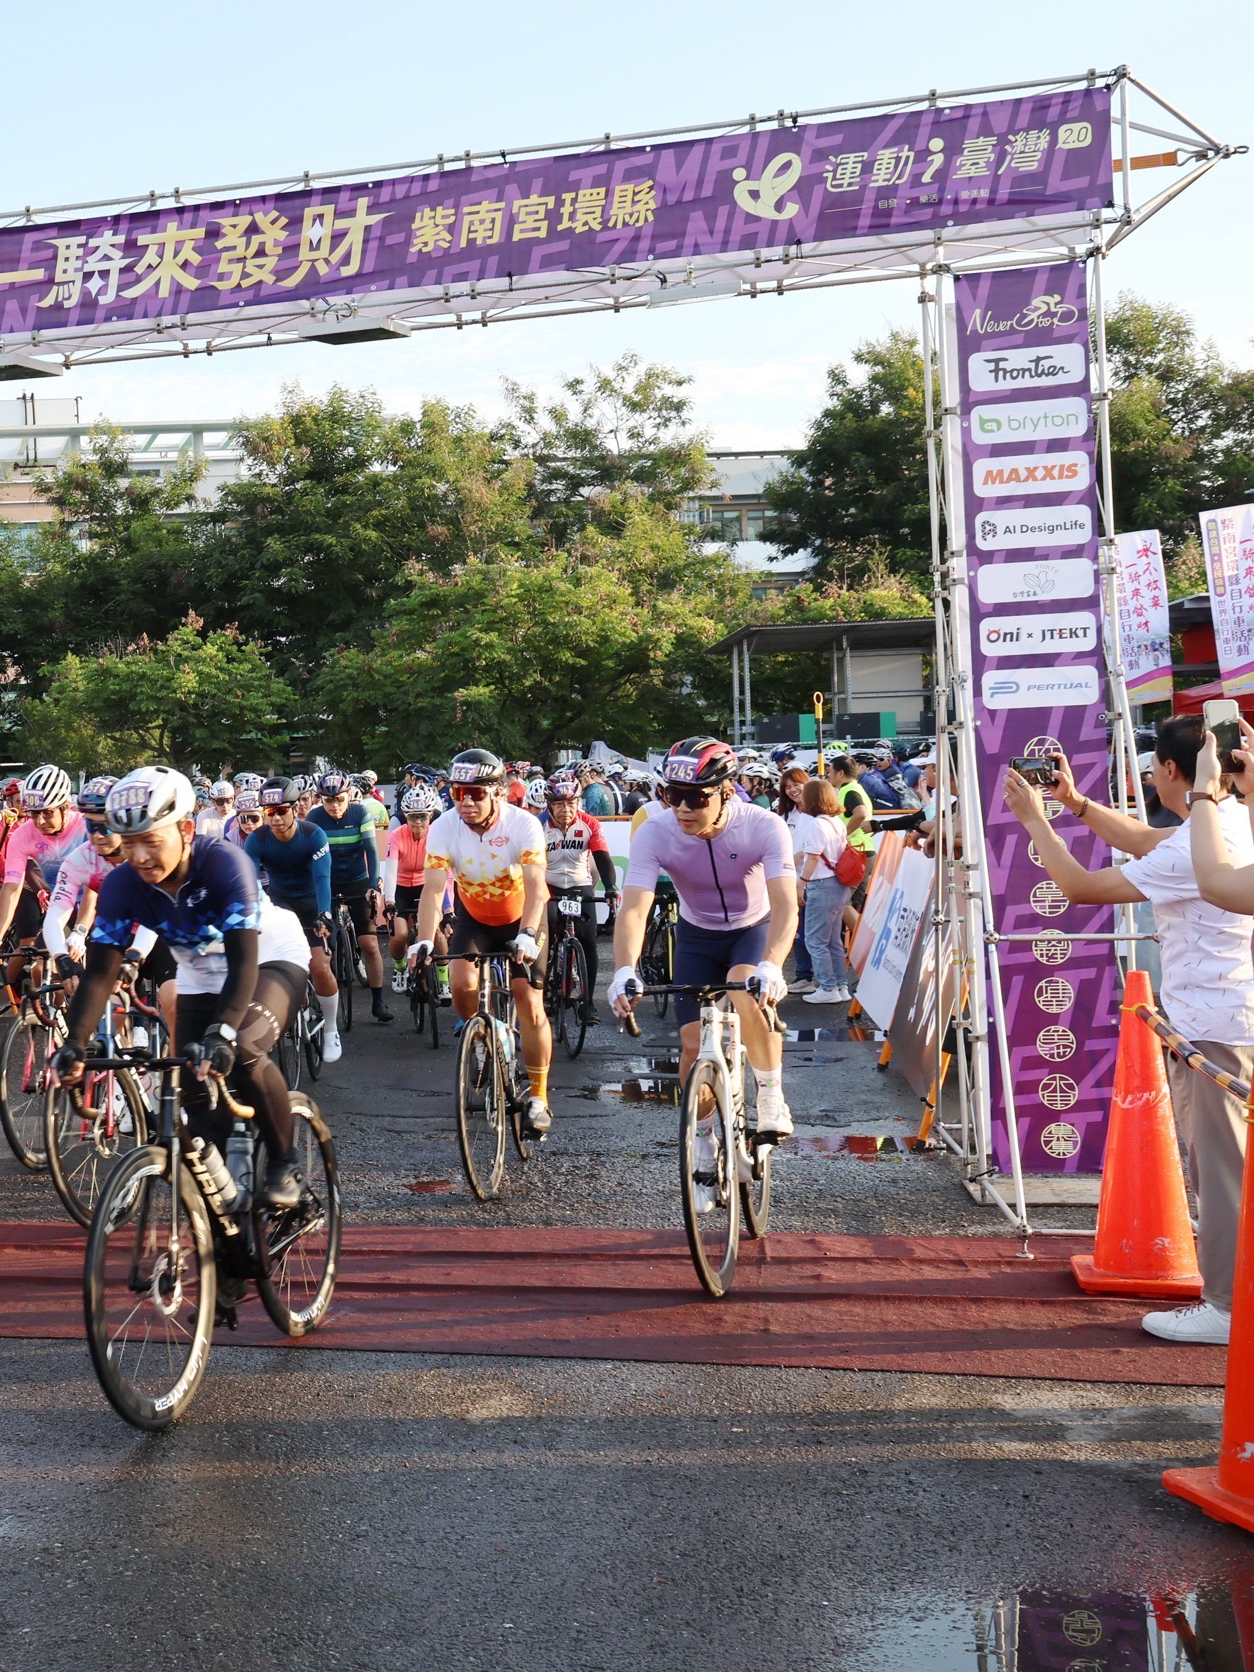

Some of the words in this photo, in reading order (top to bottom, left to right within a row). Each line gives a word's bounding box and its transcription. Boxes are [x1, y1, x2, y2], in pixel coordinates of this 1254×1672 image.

[1062, 124, 1090, 146] 2.0
[409, 179, 657, 254] 紫南宮環縣
[982, 355, 1071, 384] Frontier
[1008, 411, 1078, 432] bryton
[982, 463, 1078, 486] MAXXIS
[1020, 520, 1086, 537] DesignLife
[1136, 540, 1164, 611] 永不放棄
[1040, 627, 1090, 642] JTEKT
[1027, 681, 1092, 691] PERTUAL
[112, 787, 147, 810] 2788
[265, 794, 279, 803] 579
[561, 902, 579, 913] 963
